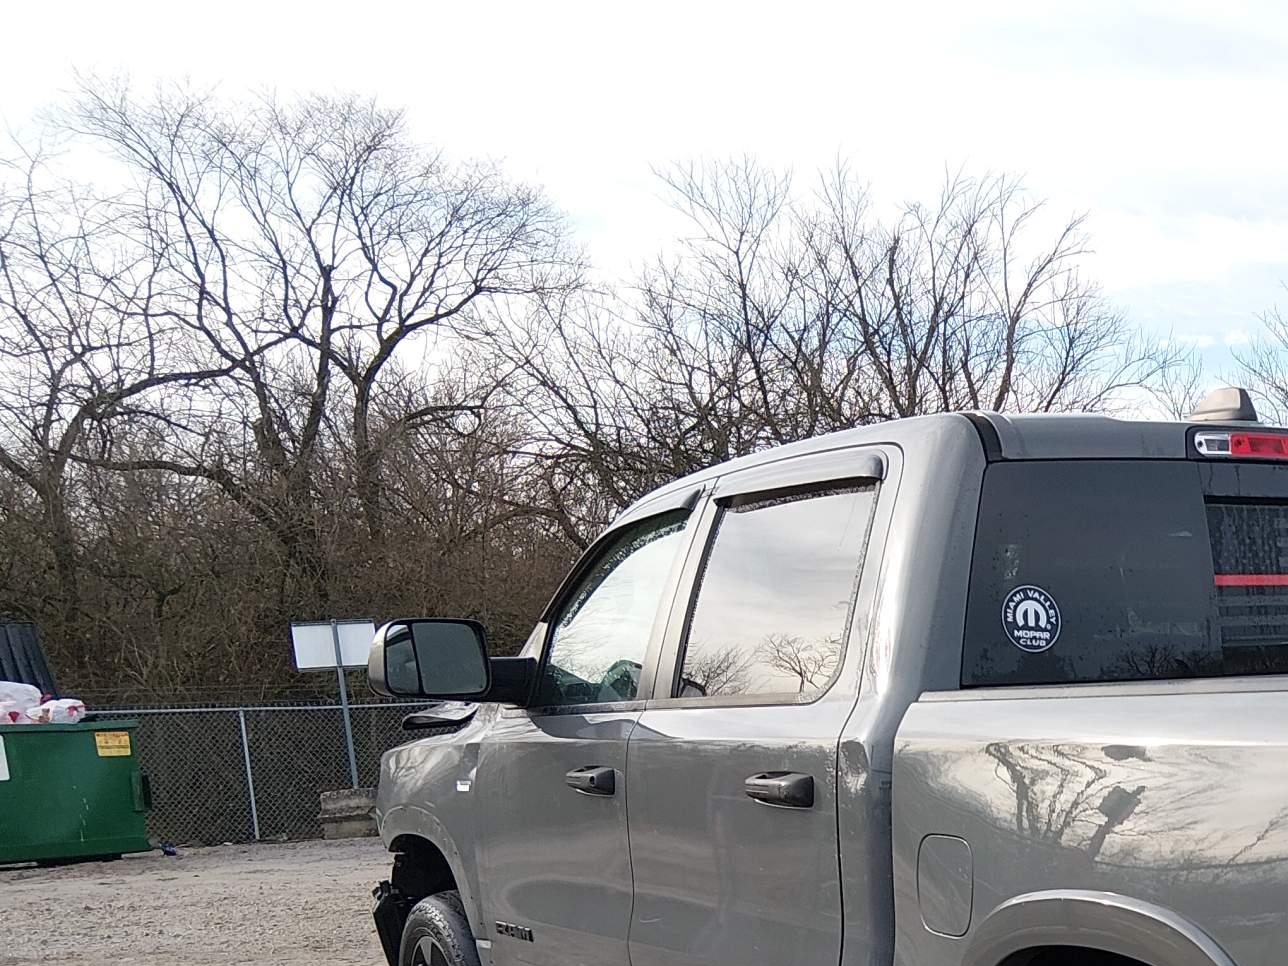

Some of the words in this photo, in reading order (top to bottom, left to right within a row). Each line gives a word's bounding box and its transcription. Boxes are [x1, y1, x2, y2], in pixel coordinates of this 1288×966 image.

[1006, 591, 1025, 622] MIAMI
[1027, 589, 1057, 625] VALLEY
[1014, 629, 1051, 640] MOPAR
[1020, 638, 1047, 647] CLUB
[496, 920, 534, 943] RAM
